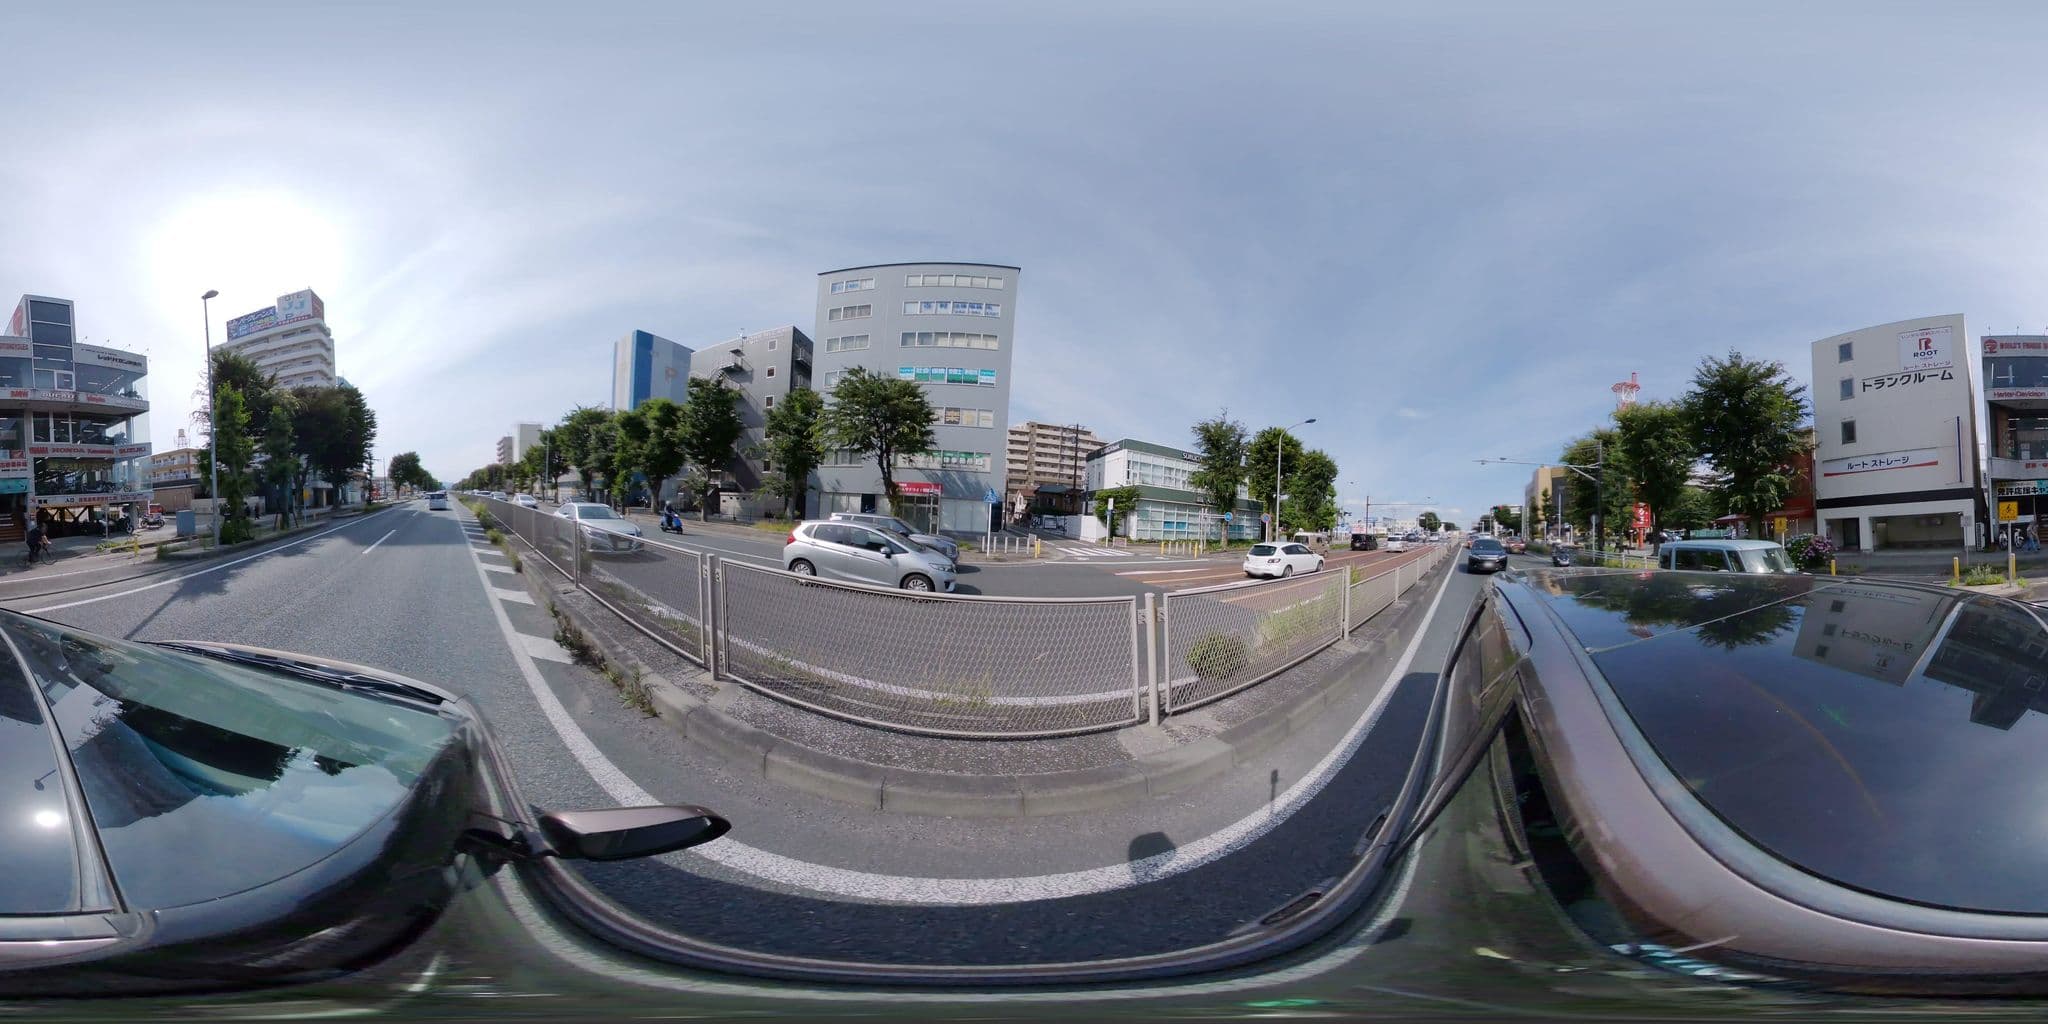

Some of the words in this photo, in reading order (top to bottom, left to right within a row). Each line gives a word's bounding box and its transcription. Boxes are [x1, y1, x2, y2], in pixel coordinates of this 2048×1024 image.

[1913, 350, 1938, 358] ROOT
[1863, 370, 1953, 392] トランクルーム
[119, 447, 146, 455] SUZUKI
[1847, 461, 1868, 470] ルート
[1871, 456, 1910, 468] ストレージ
